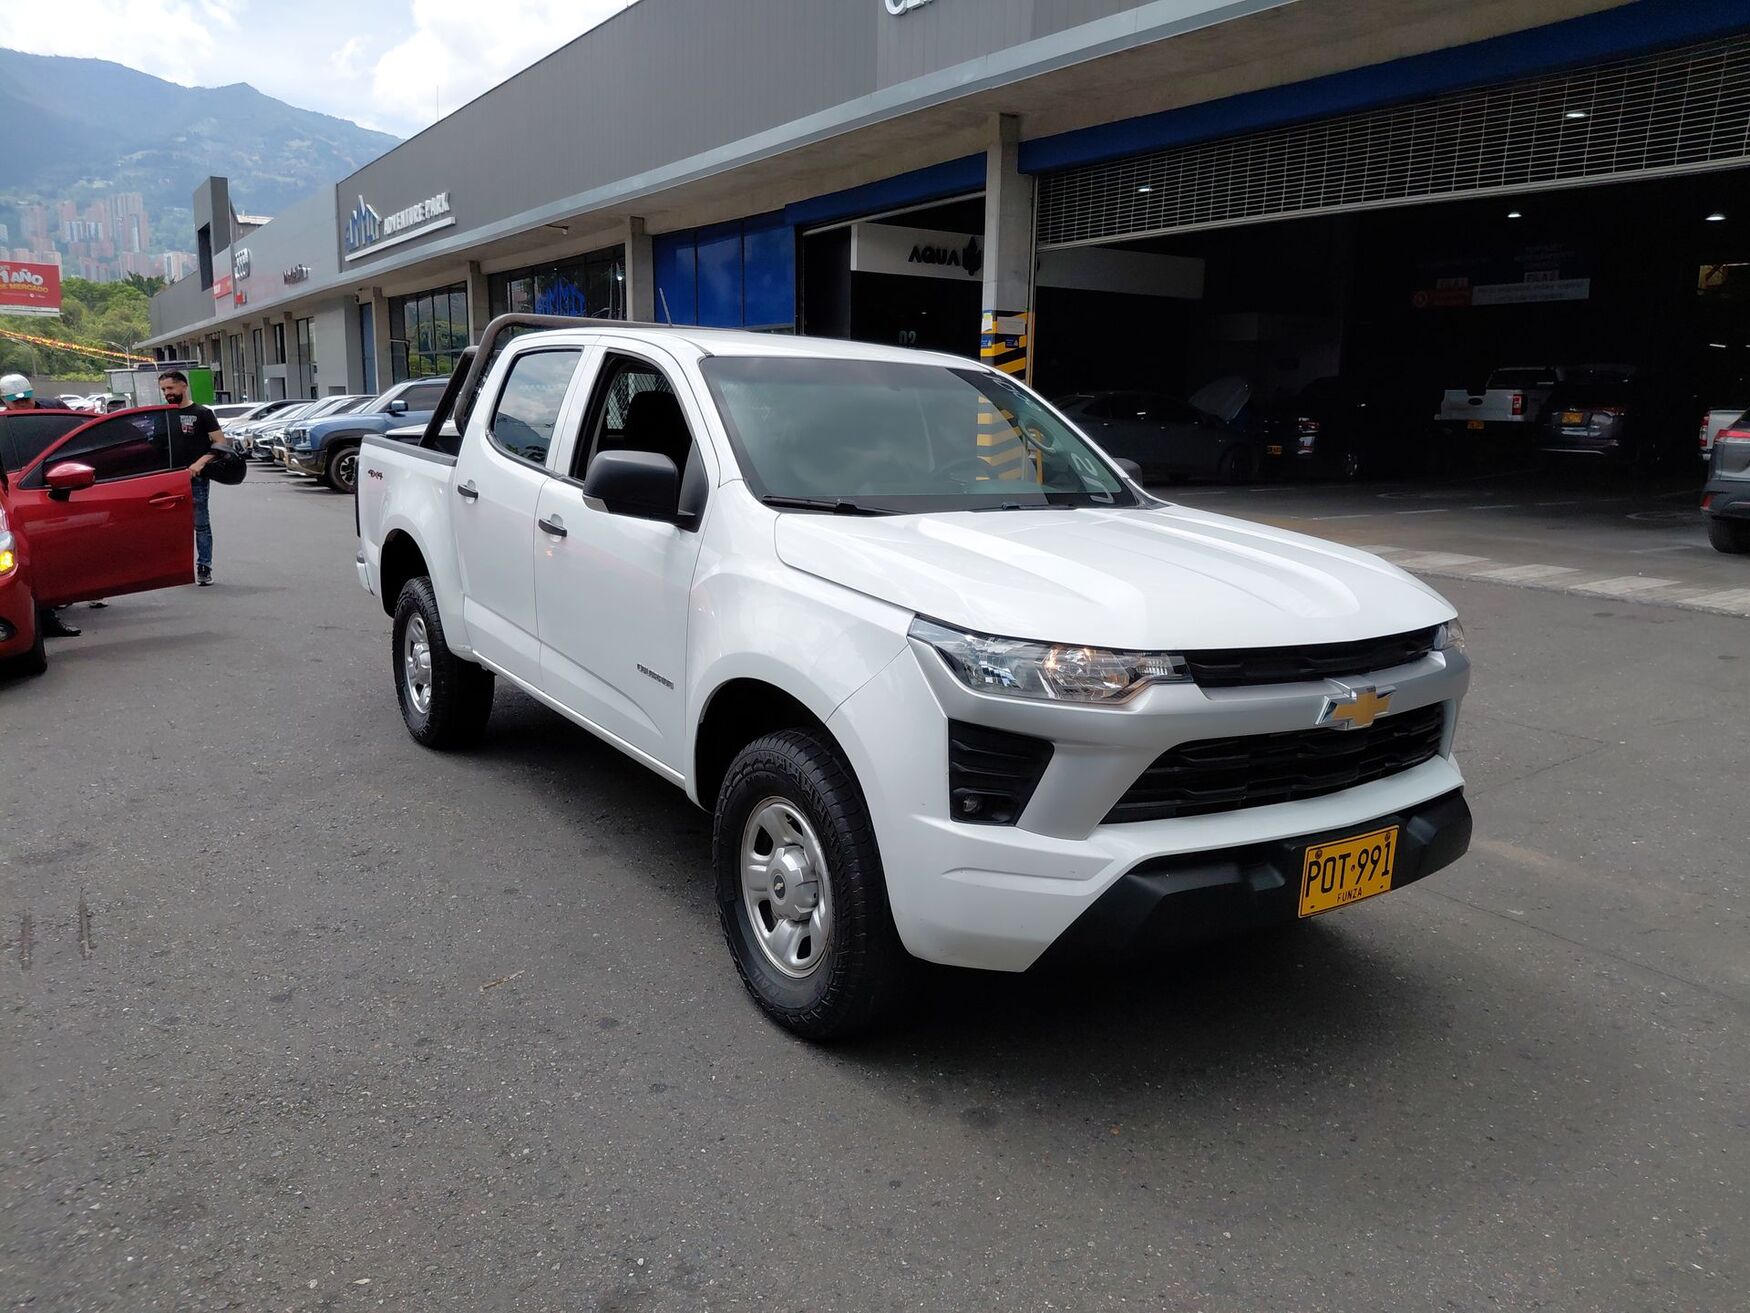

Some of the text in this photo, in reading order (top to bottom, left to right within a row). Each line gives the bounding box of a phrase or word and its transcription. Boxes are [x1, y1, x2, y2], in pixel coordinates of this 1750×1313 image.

[384, 192, 450, 234] ADVENTURE PARK
[909, 246, 960, 267] AQUA
[12, 269, 43, 285] AÑO
[9, 283, 48, 292] MERCADO
[1337, 888, 1362, 902] FUNZA
